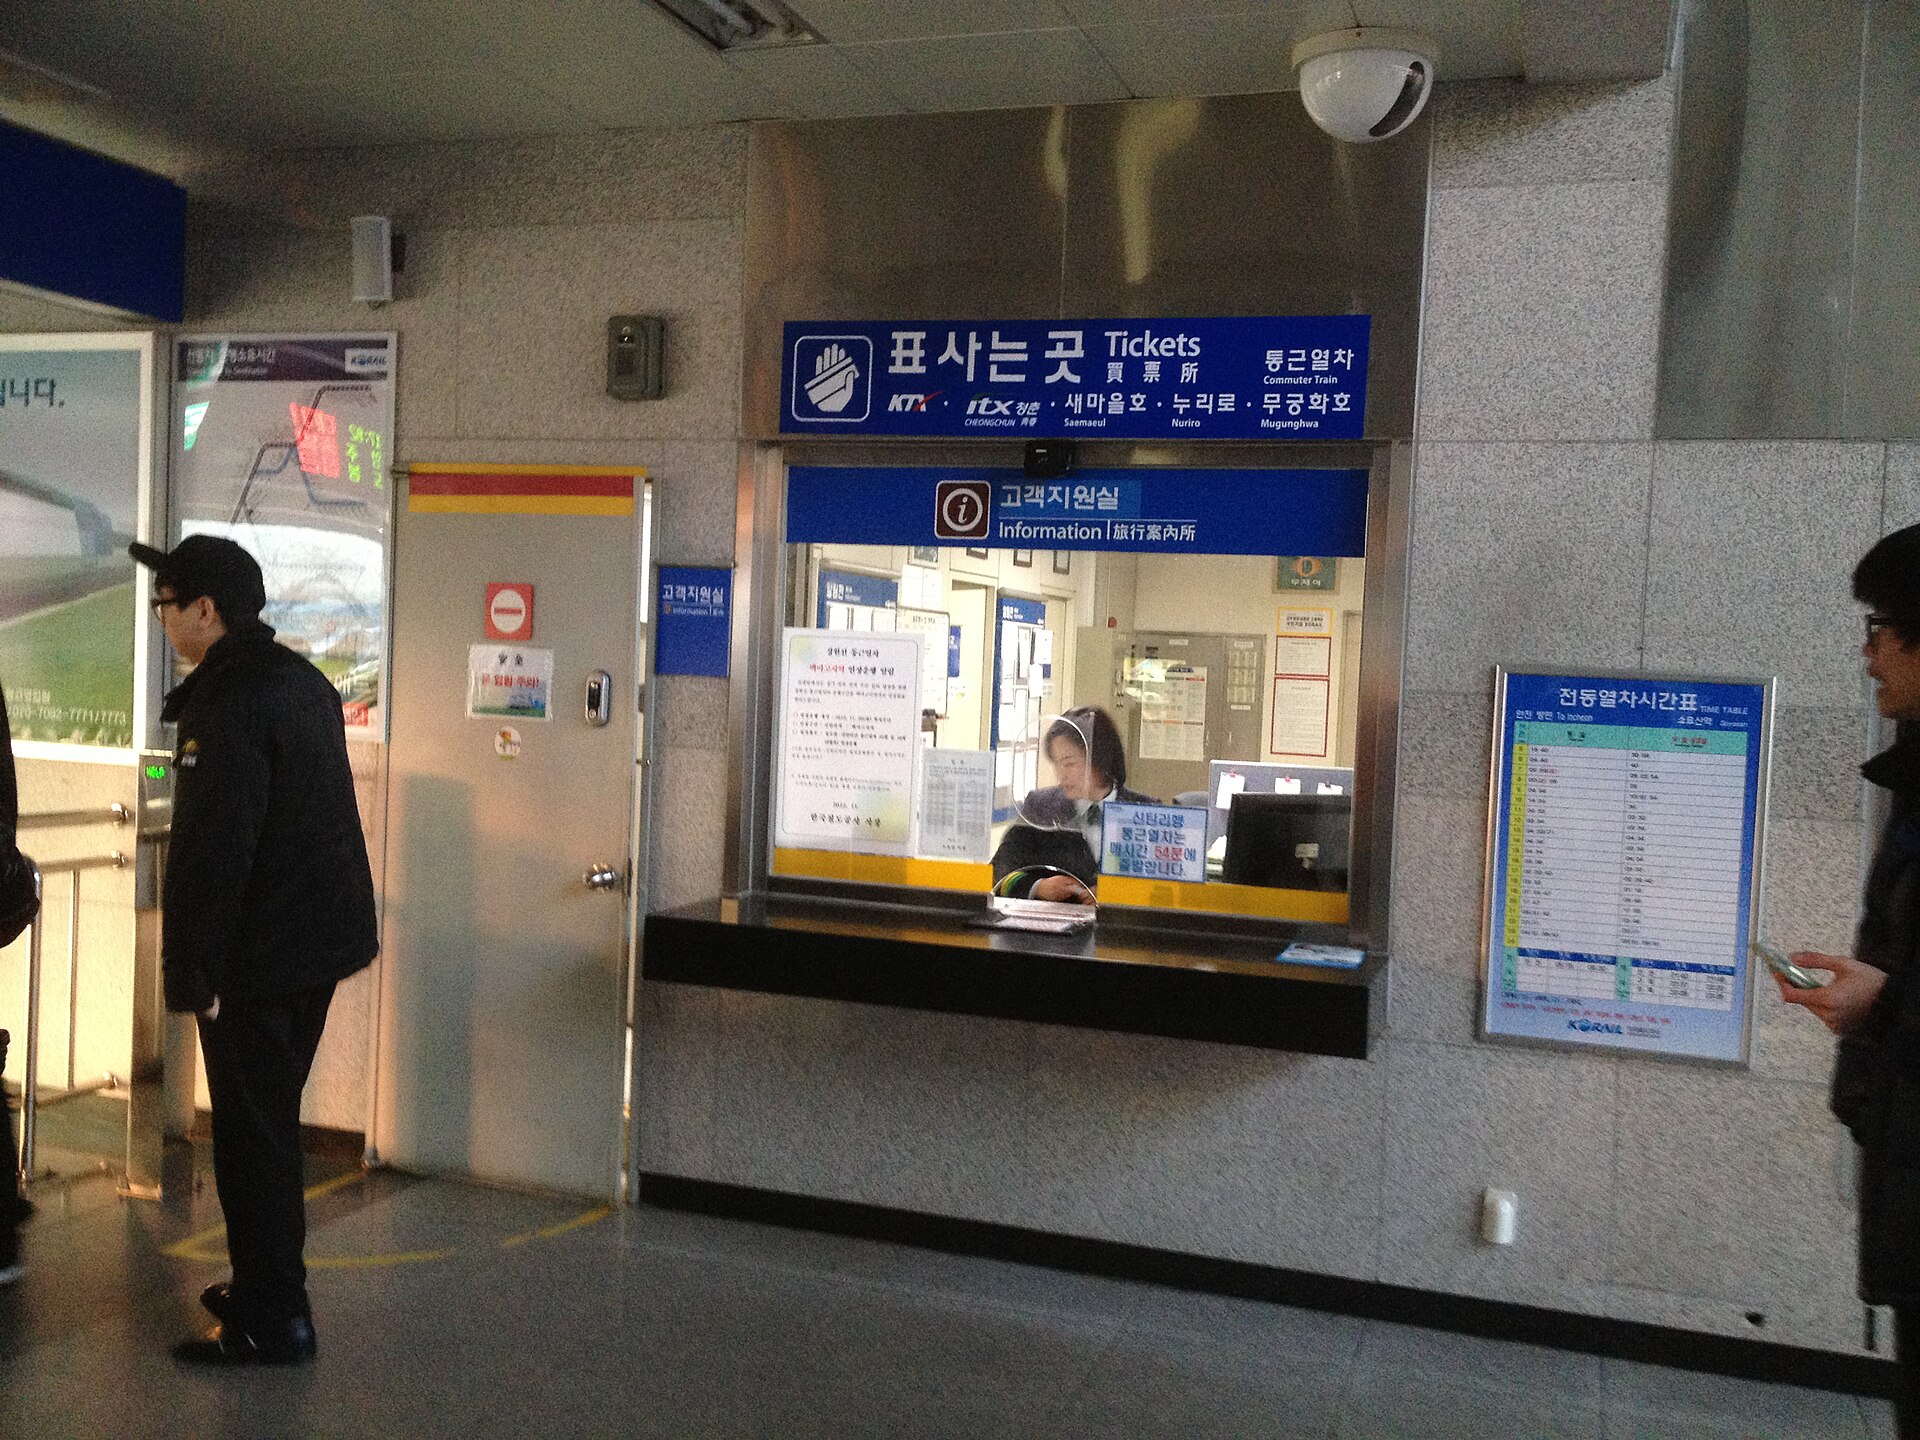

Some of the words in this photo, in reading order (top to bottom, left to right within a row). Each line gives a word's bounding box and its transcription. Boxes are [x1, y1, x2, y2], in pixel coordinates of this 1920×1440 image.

[1104, 329, 1201, 358] Tickets
[888, 330, 927, 375] 표
[937, 331, 1028, 382] 사는
[1044, 330, 1085, 384] 곳
[1264, 348, 1355, 373] 통근열차
[1262, 375, 1313, 386] Commuter
[1314, 375, 1339, 386] Train
[888, 392, 938, 412] KTX
[1064, 392, 1148, 416] 새마을호
[1172, 392, 1237, 416] 누리로
[1261, 391, 1352, 416] 무궁화호
[964, 417, 1017, 428] CHEONGCHUN
[1063, 417, 1107, 428] Saemaeul
[1170, 417, 1202, 429] Nuriro
[1259, 418, 1320, 431] Mugunghwa
[1000, 484, 1120, 511] 고객지원실
[998, 521, 1103, 541] Information
[662, 584, 725, 605] 고객지원실
[672, 606, 709, 617] Information
[1559, 687, 1698, 711] 전동열차시간표
[1700, 704, 1720, 715] TIME
[1722, 705, 1748, 716] TABLE
